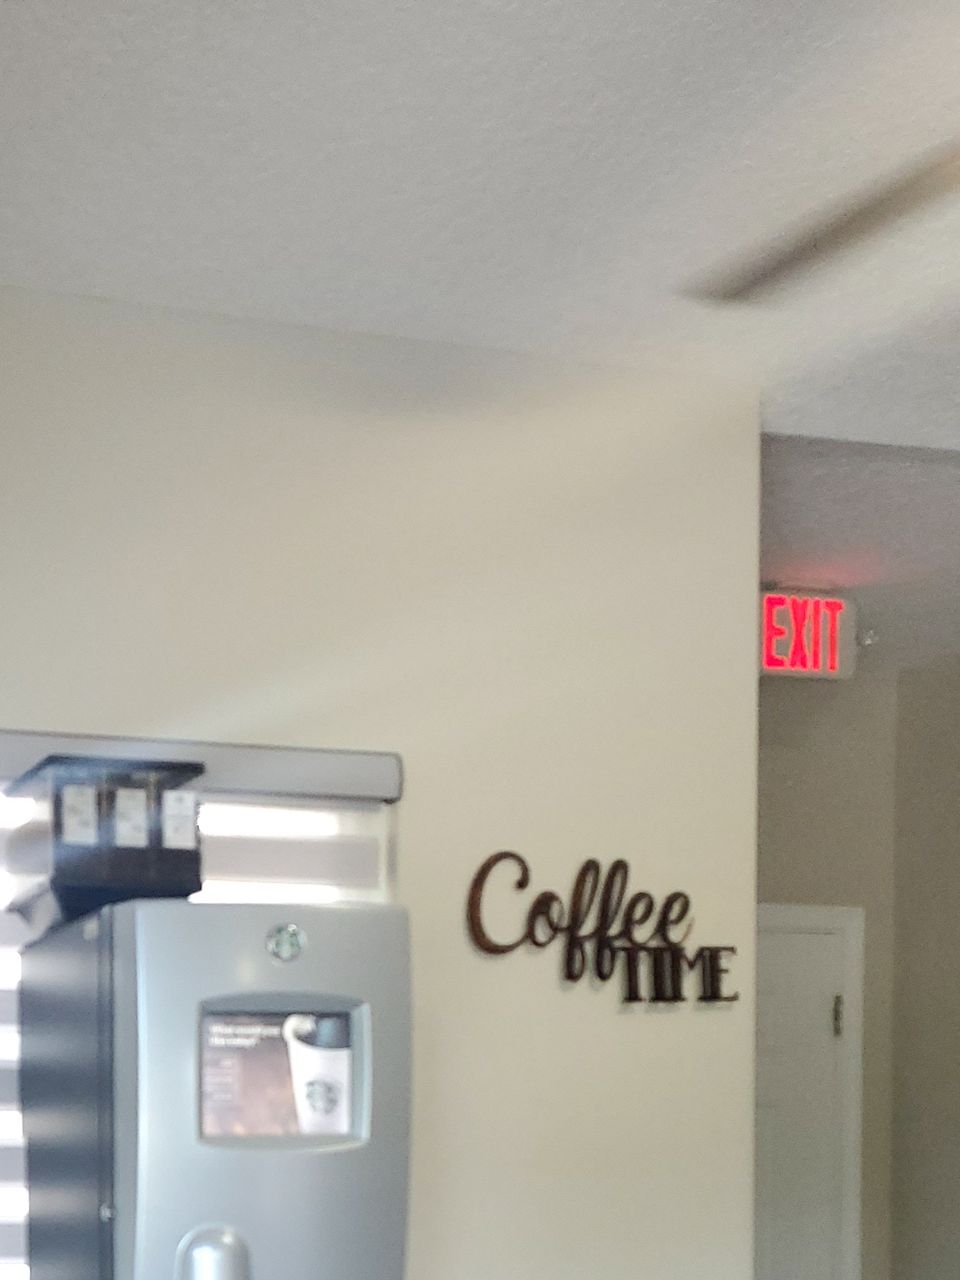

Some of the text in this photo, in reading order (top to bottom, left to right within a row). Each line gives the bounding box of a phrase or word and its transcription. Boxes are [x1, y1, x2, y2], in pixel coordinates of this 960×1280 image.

[763, 594, 844, 672] EXIT
[467, 851, 694, 981] Coffee
[612, 946, 739, 1003] TIME
